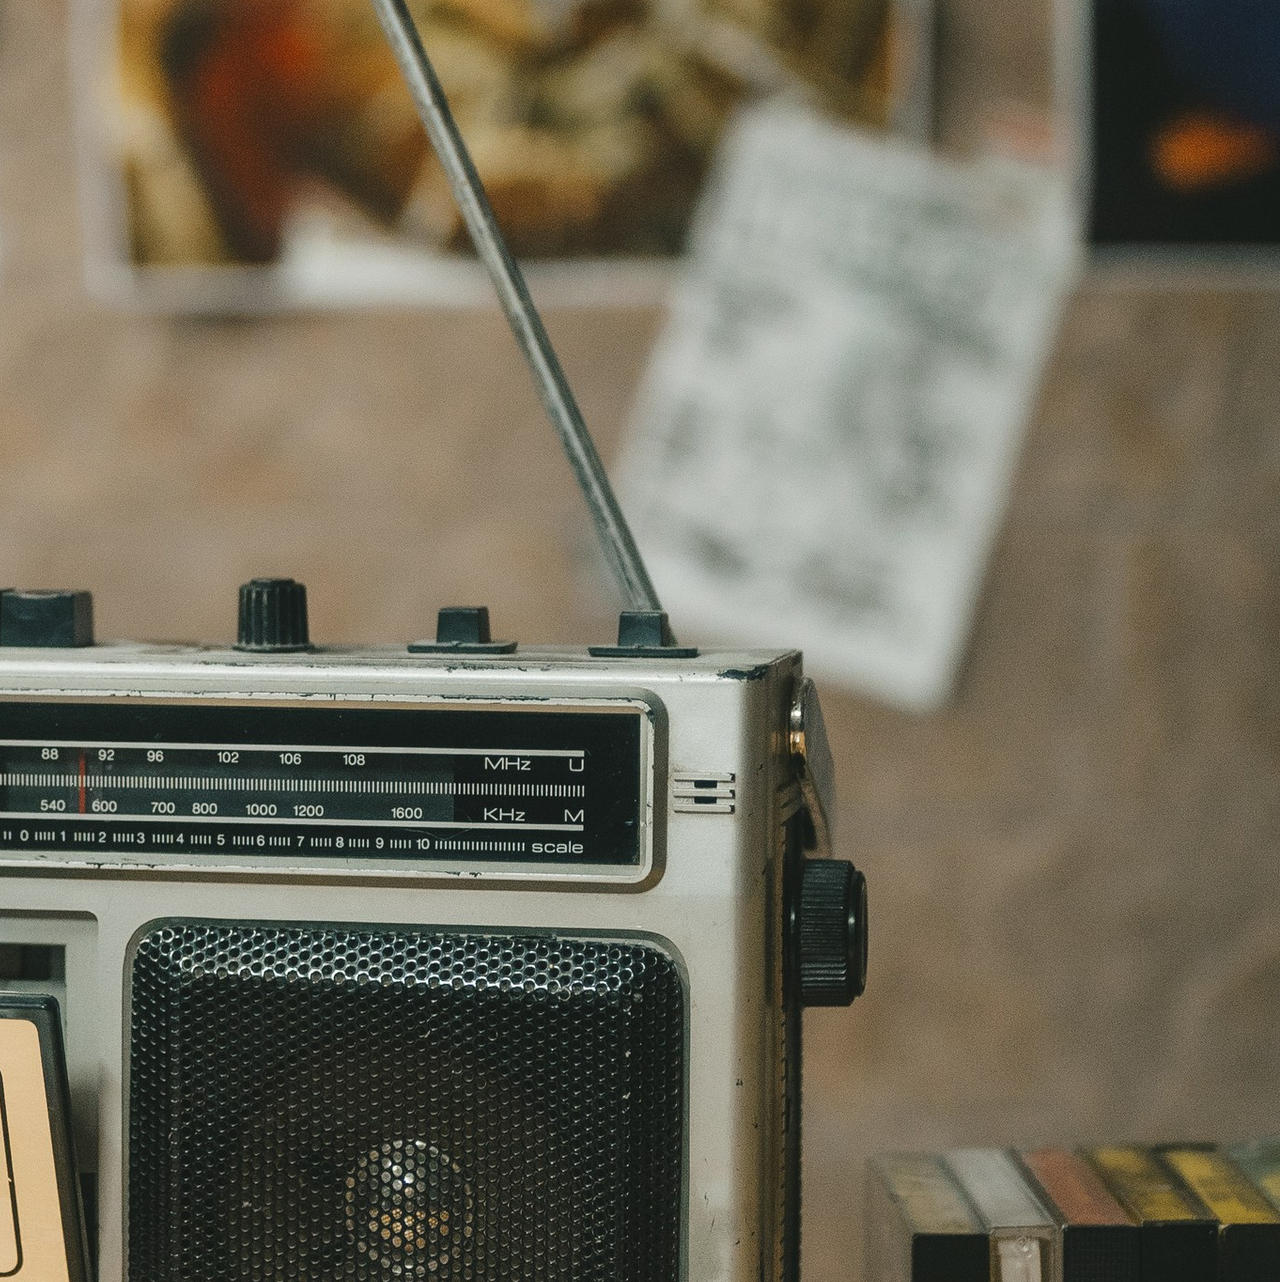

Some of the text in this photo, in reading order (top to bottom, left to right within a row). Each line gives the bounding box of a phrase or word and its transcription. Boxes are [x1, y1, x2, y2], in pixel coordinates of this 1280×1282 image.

[41, 748, 60, 761] 88
[98, 749, 115, 761] 92
[147, 750, 164, 763] 96
[217, 751, 239, 764] 102
[278, 752, 302, 765] 106
[342, 753, 366, 766] 108
[484, 757, 532, 771] MHz
[569, 758, 585, 772] U
[40, 799, 66, 812] 540
[91, 800, 118, 813] 600
[150, 801, 176, 814] 700
[192, 802, 218, 815] 800
[245, 803, 278, 816] 1000
[293, 804, 325, 817] 1200
[391, 806, 423, 819] 1600
[483, 807, 526, 822] KHz
[564, 809, 585, 823] M
[19, 829, 30, 842] 0
[59, 831, 67, 842] 1
[98, 831, 107, 844] 2
[136, 832, 146, 844] 3
[176, 833, 185, 845] 4
[216, 834, 226, 846] 5
[256, 835, 266, 847] 6
[296, 835, 305, 847] 7
[335, 836, 345, 848] 8
[375, 837, 385, 849] 9
[416, 838, 431, 850] 10
[531, 842, 585, 855] scale
